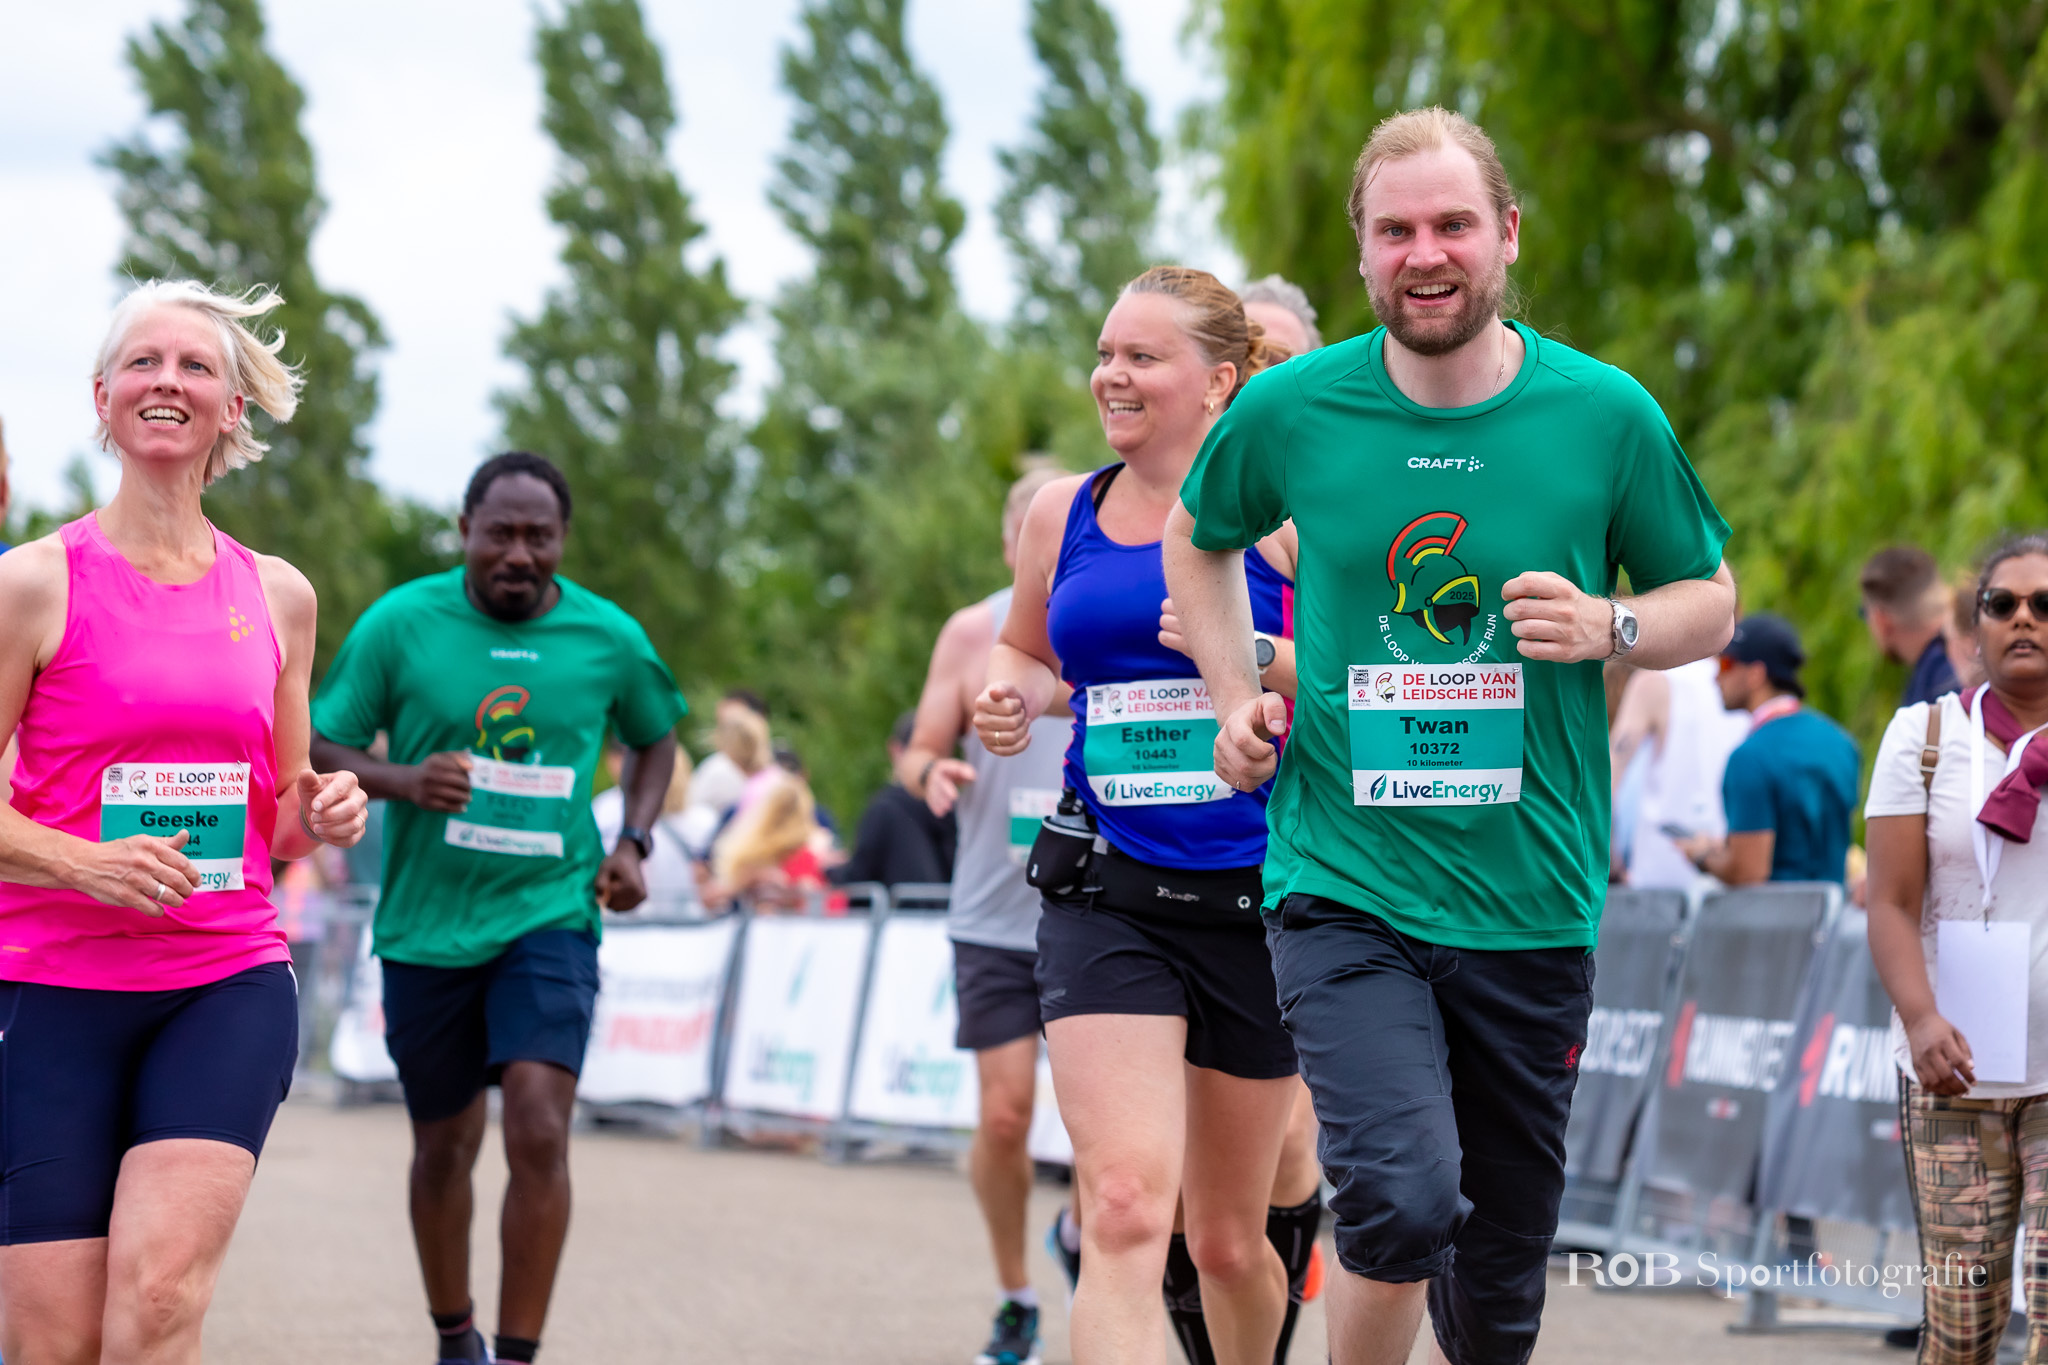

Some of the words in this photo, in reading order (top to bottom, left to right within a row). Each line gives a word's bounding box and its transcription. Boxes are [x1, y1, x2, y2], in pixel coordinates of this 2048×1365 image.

[1407, 457, 1466, 470] CRAFT
[1450, 591, 1475, 600] 2025
[1378, 615, 1390, 633] DE
[1484, 613, 1497, 641] RIJN
[1383, 633, 1409, 662] LOOP
[1403, 673, 1425, 686] DE
[1430, 673, 1476, 686] LOOP
[1480, 672, 1516, 685] VAN
[1127, 689, 1146, 701] DE
[1150, 688, 1190, 699] LOOP
[1403, 688, 1478, 700] LEIDSCHE
[1482, 687, 1516, 699] RIJN
[1127, 702, 1192, 713] LEIDSCHE
[1400, 716, 1469, 734] Twan
[1121, 726, 1191, 743] Esther
[1135, 748, 1177, 760] 10443
[1409, 743, 1460, 755] 10372
[1406, 759, 1418, 767] 10
[1420, 759, 1463, 767] kilometer
[156, 772, 175, 783] DE
[179, 772, 215, 783] LOOP
[218, 772, 244, 783] VAN
[155, 786, 216, 797] LEIDSCHE
[220, 786, 244, 796] RIJN
[1121, 782, 1216, 801] LiveEnergy
[1392, 780, 1503, 803] LiveEnergy
[140, 811, 219, 827] Geeske
